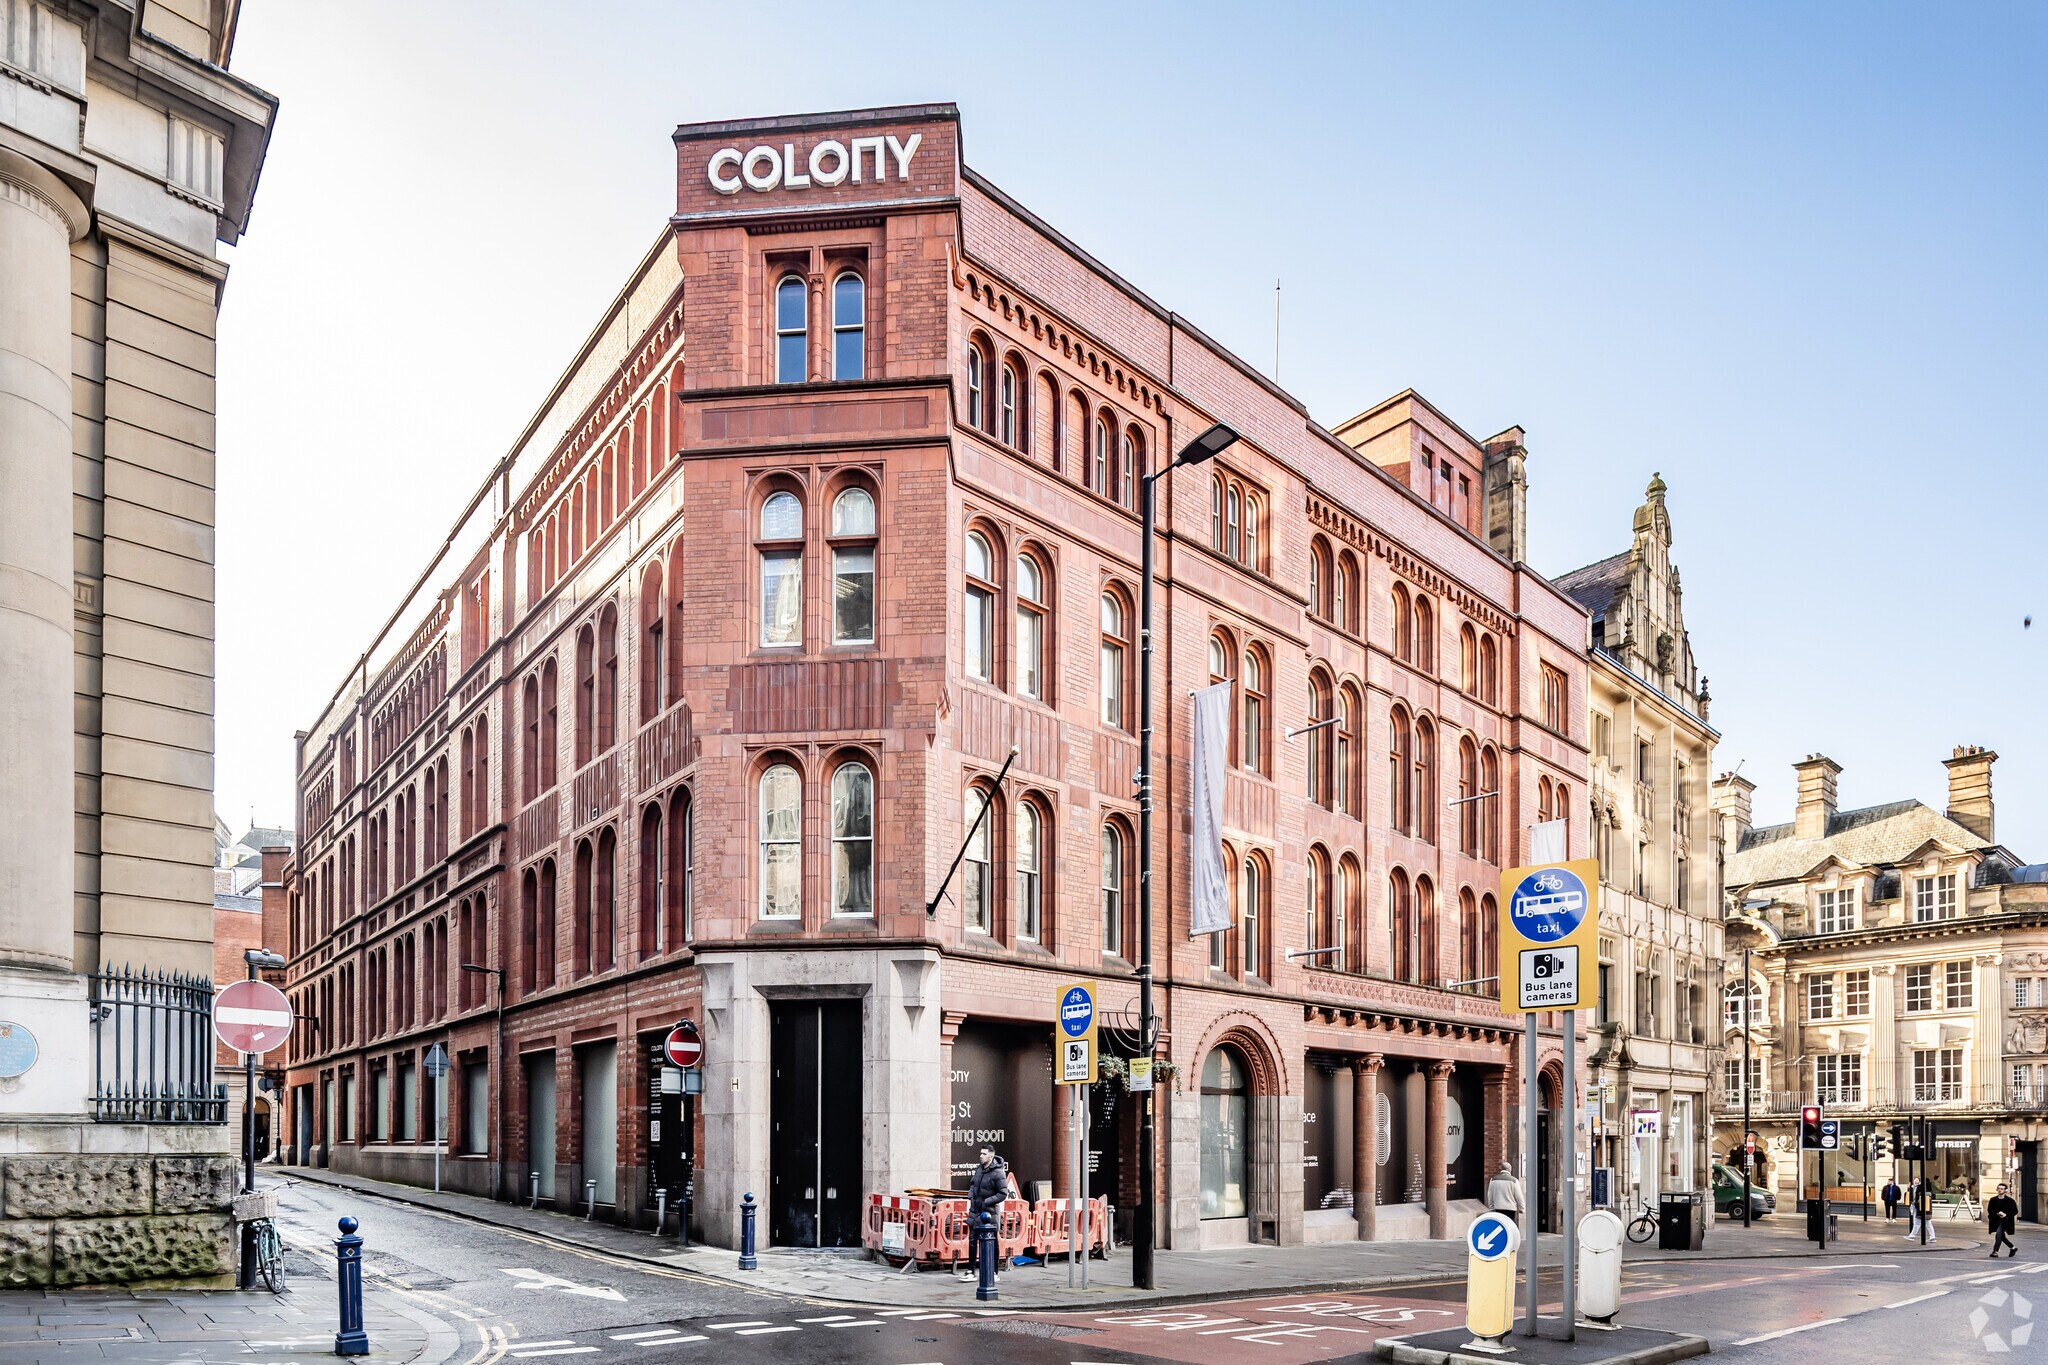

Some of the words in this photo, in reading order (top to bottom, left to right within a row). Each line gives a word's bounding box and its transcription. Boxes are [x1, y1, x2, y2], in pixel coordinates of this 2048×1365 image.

[707, 133, 922, 195] COLONY
[1537, 922, 1560, 933] taxi
[1525, 983, 1546, 992] Bus
[1549, 981, 1573, 990] lane
[1526, 992, 1572, 1002] cameras
[1071, 1023, 1081, 1031] taxi
[731, 1078, 739, 1090] H
[958, 1101, 971, 1118] St
[977, 1129, 1005, 1142] soon
[1257, 1301, 1455, 1321] BUS
[1094, 1313, 1369, 1345] GATE
